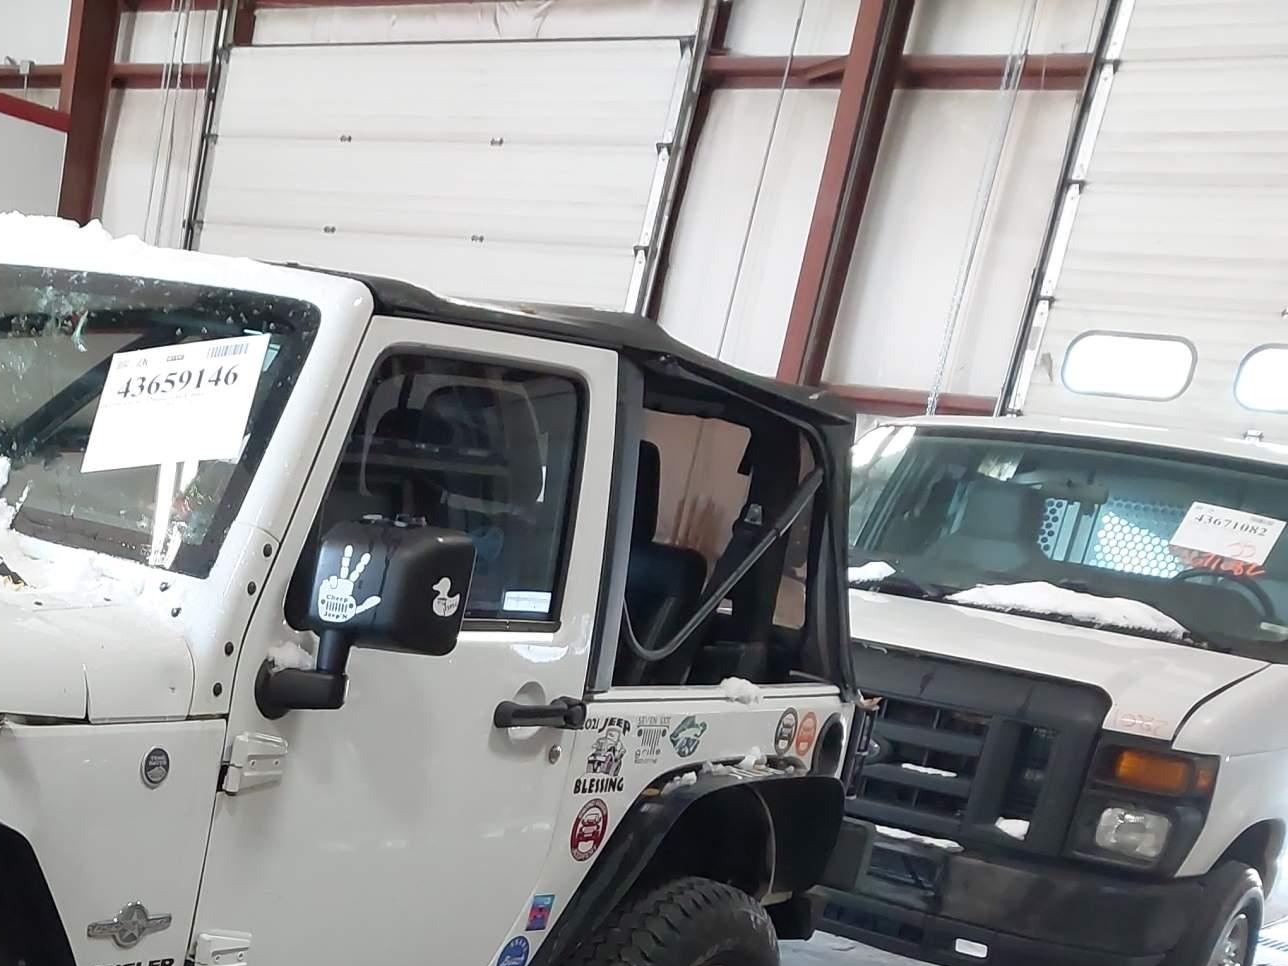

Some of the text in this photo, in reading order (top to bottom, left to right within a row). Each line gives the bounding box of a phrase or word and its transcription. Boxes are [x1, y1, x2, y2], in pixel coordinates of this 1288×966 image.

[117, 363, 240, 398] 43659146
[1194, 514, 1268, 537] 43671082
[597, 716, 631, 736] JEEP
[573, 777, 624, 794] BLESSING
